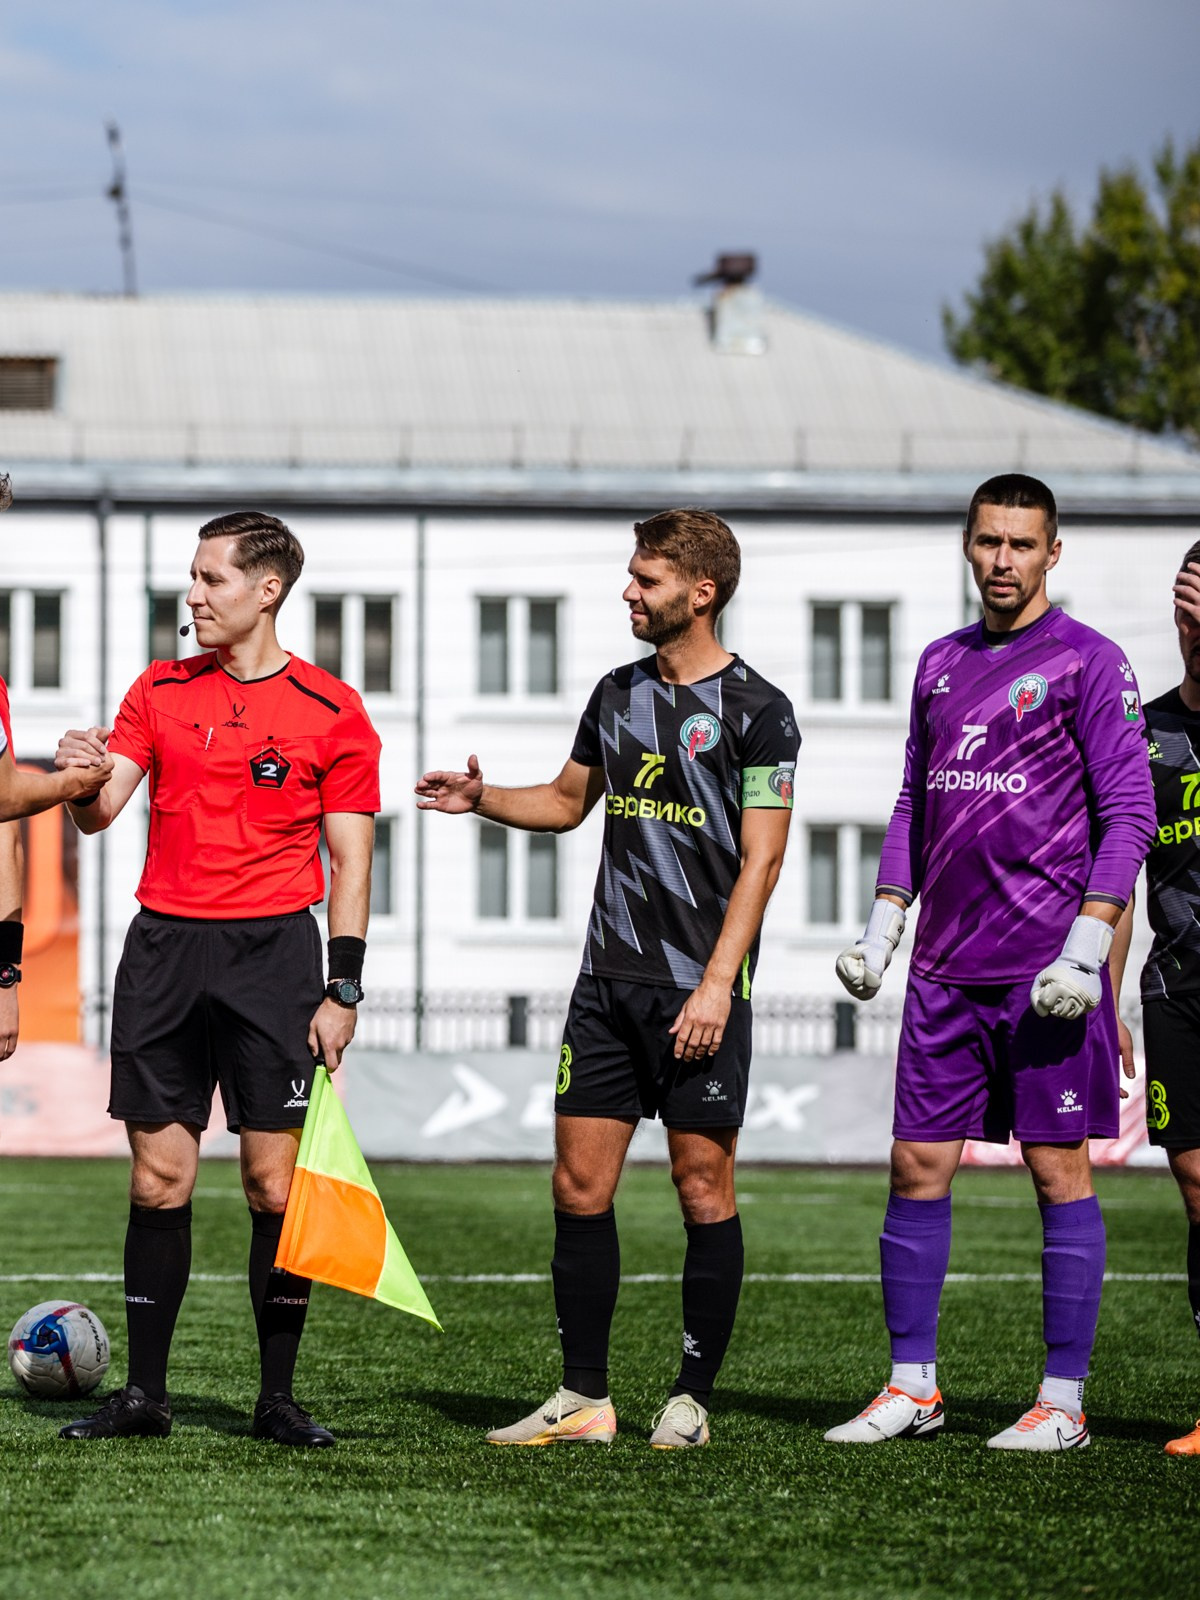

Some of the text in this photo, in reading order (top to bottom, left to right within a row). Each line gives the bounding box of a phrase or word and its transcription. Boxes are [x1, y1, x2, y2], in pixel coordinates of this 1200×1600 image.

[261, 763, 278, 777] 2
[926, 770, 1027, 794] сервико
[606, 794, 706, 828] сервико
[283, 1099, 310, 1108] JÖGE
[1056, 1104, 1083, 1113] KELME
[1147, 1080, 1170, 1130] 8
